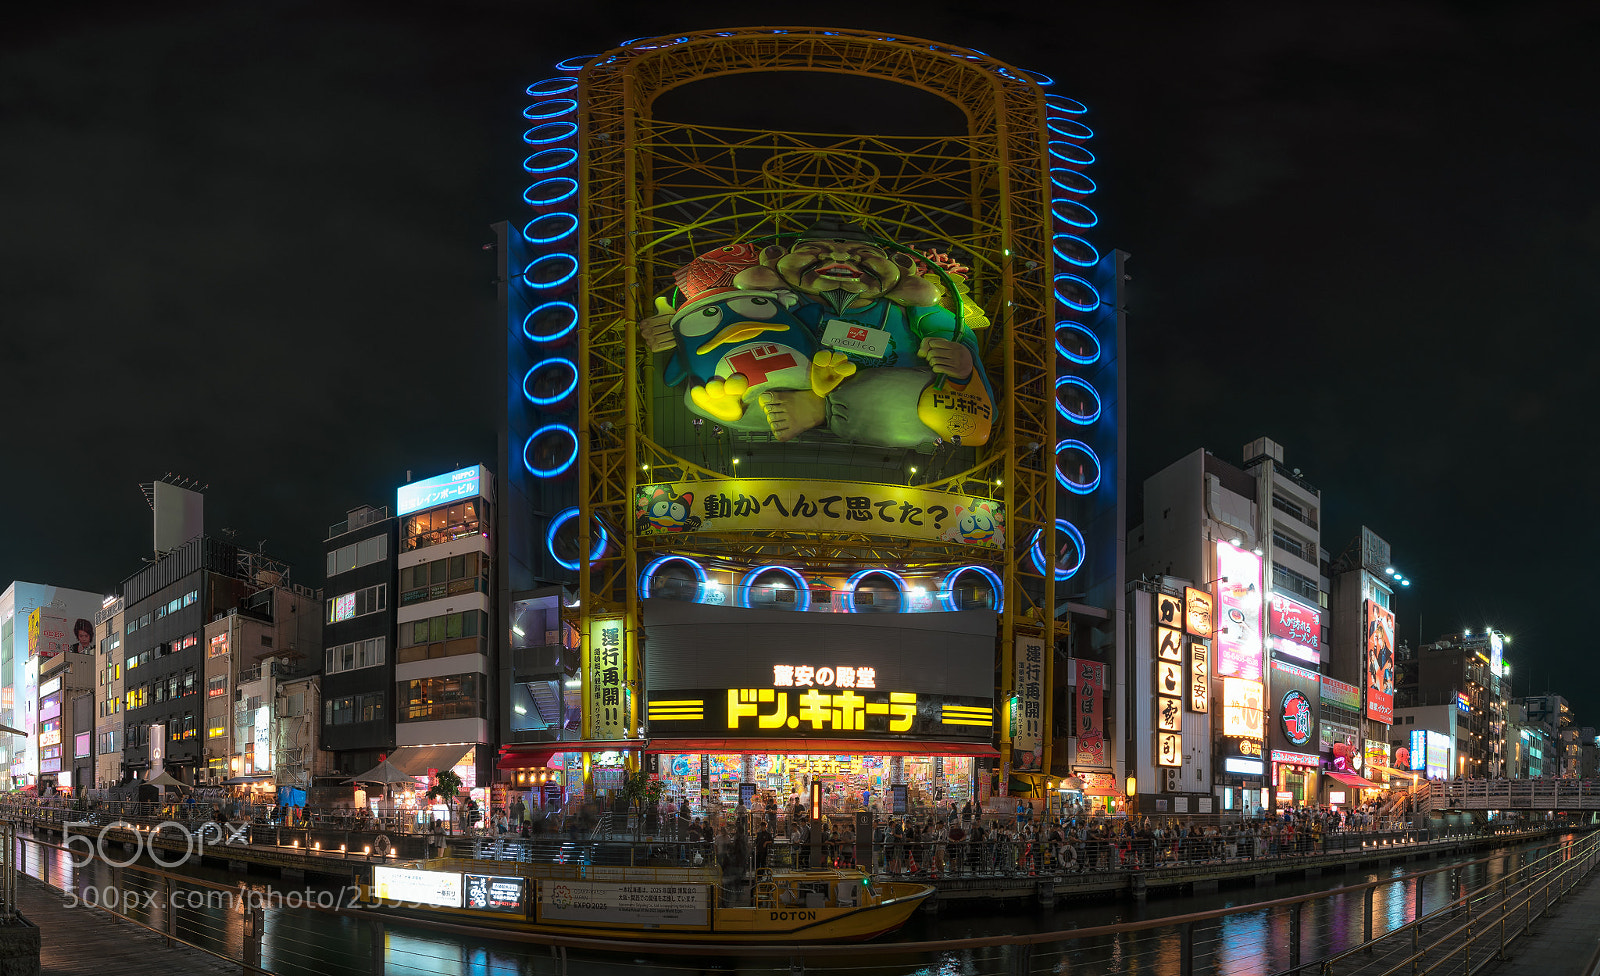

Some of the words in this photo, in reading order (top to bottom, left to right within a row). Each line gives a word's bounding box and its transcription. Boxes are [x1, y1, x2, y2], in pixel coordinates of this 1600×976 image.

[831, 337, 876, 352] majica
[452, 470, 475, 482] NIPPO
[704, 492, 949, 529] 動かへんて思てた?
[1288, 628, 1318, 648] ラーメン店
[773, 664, 876, 689] 驚安の殿堂
[1193, 645, 1206, 711] 旨くて安い
[1283, 699, 1311, 738] 一蘭
[770, 911, 816, 921] DOTON
